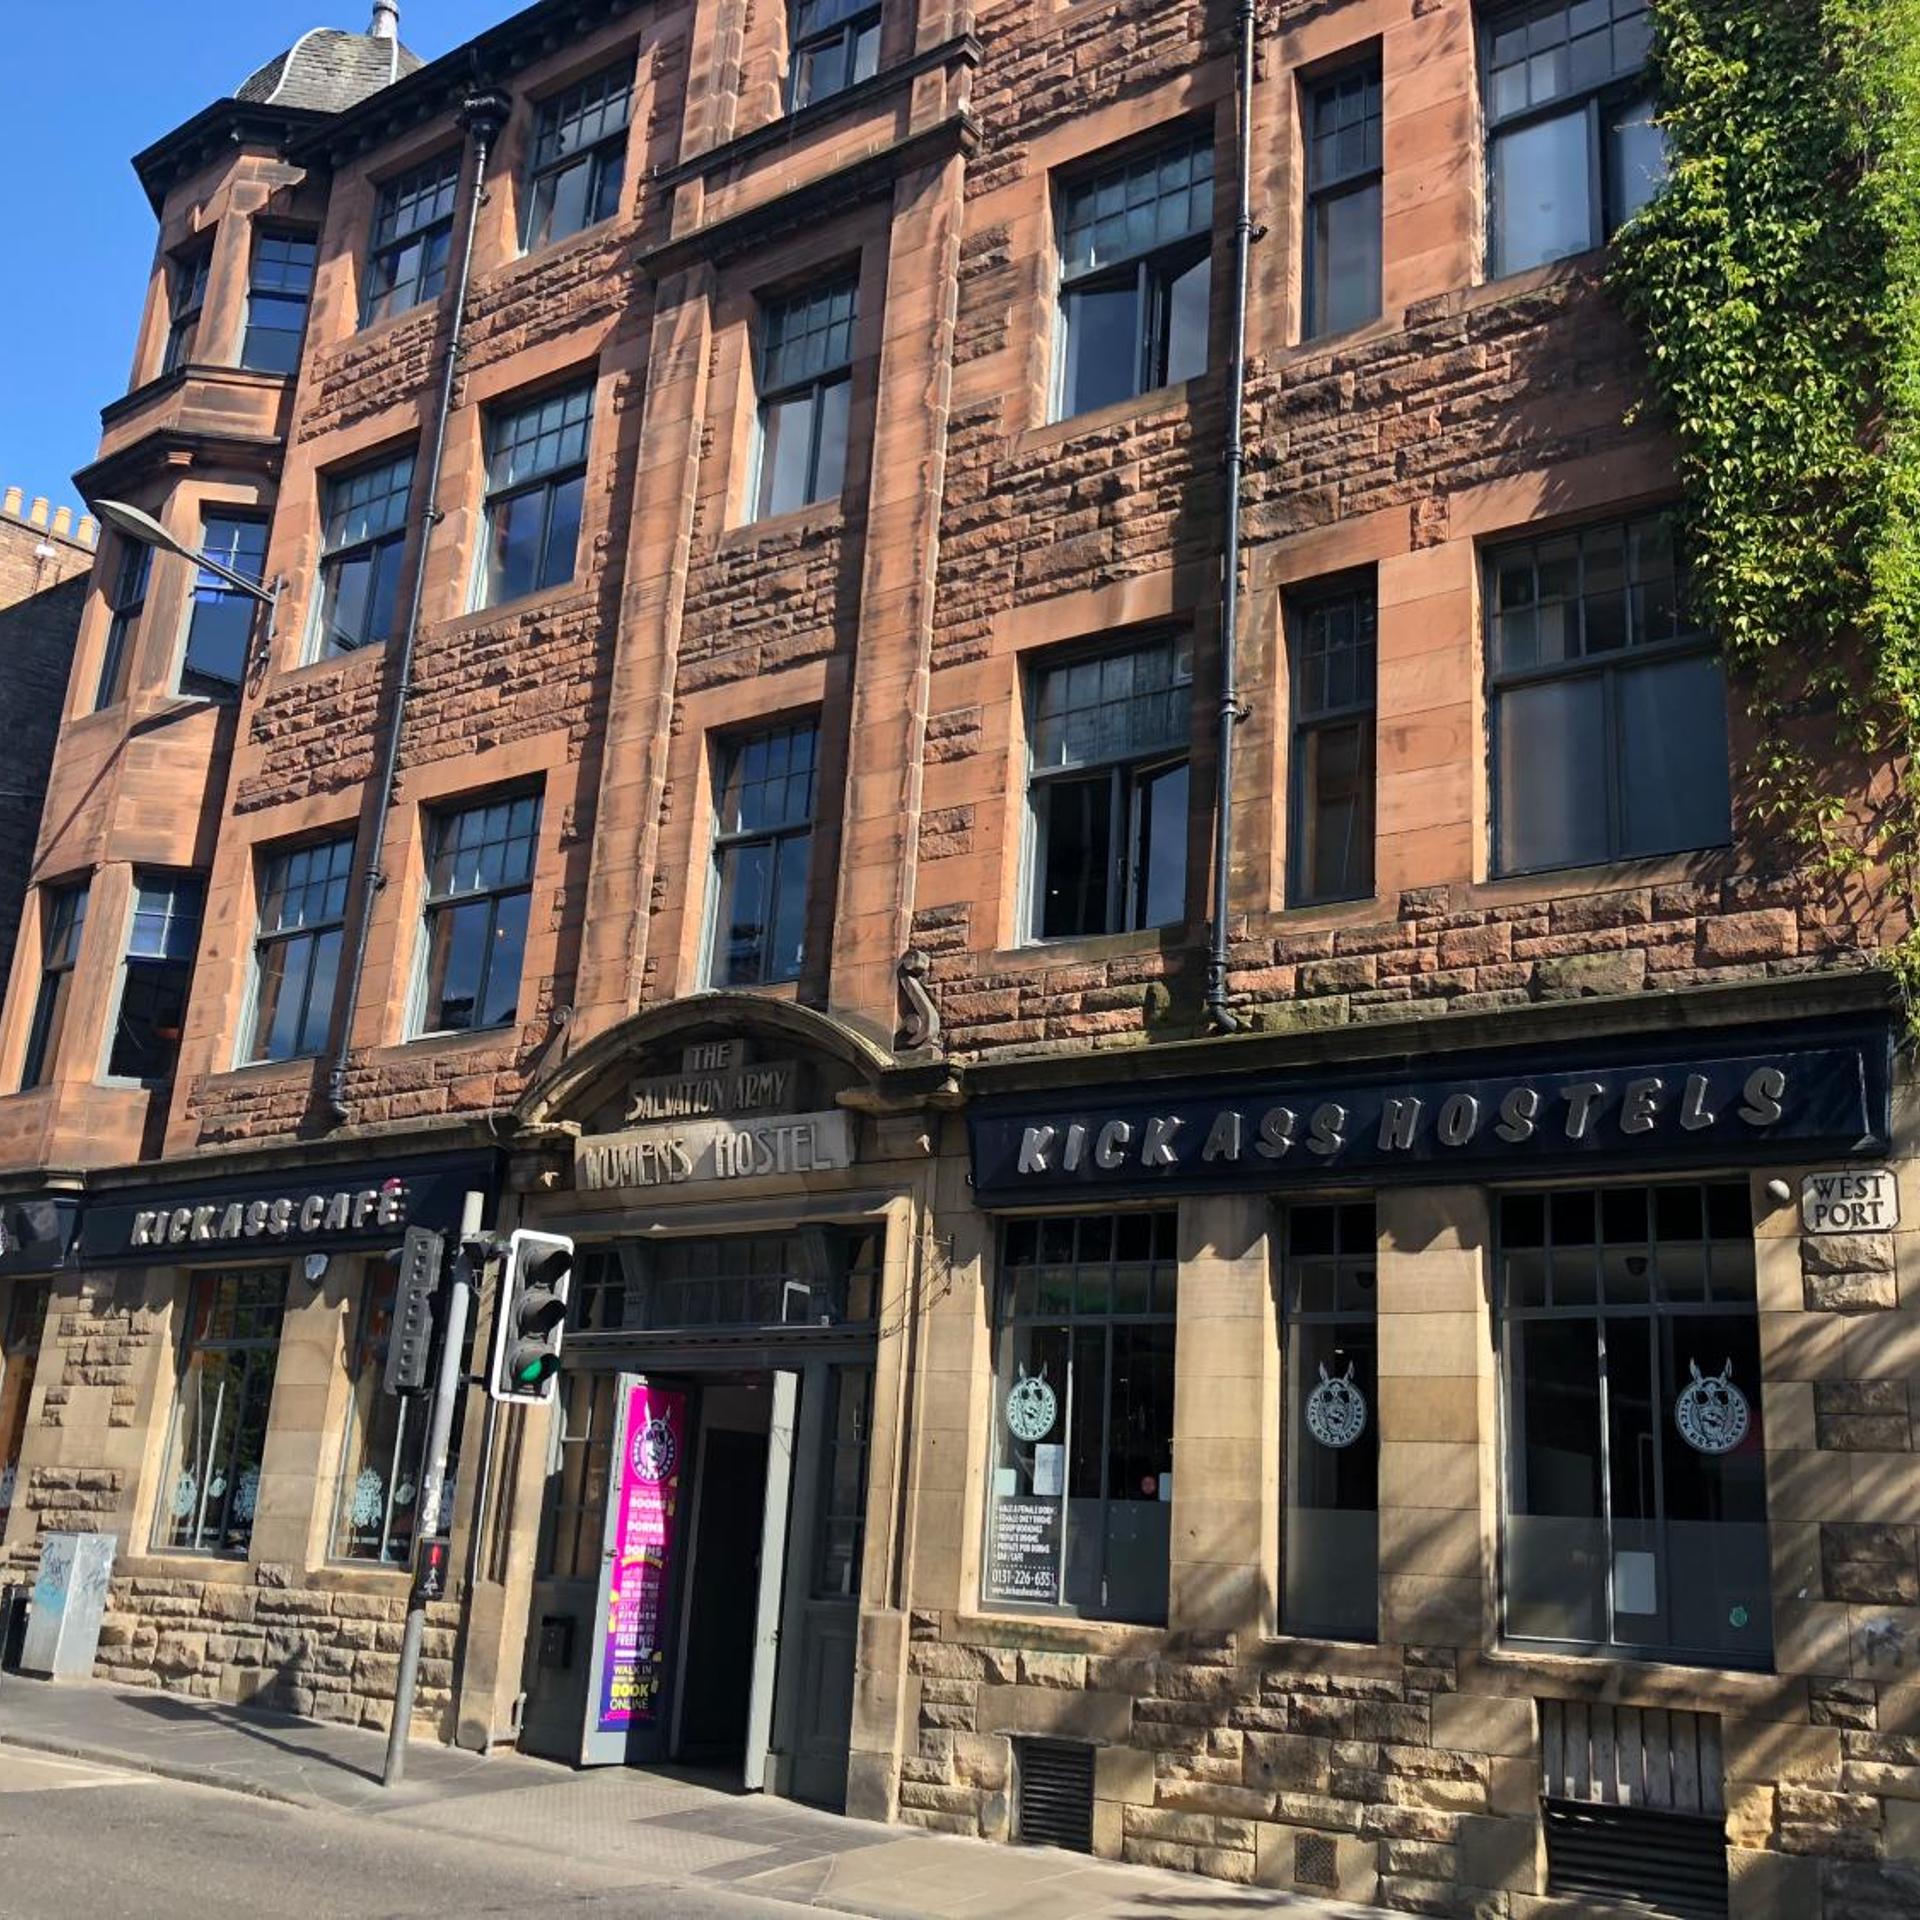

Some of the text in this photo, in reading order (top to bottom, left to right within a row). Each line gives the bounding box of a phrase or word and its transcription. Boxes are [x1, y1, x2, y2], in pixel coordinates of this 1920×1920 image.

[691, 1043, 732, 1070] THE
[625, 1071, 787, 1121] SALVATION ARMY
[1377, 1066, 1787, 1151] HOSTELS
[585, 1124, 831, 1189] WOMENS HOSTEL
[1812, 1174, 1886, 1199] WEST
[1814, 1200, 1884, 1228] PORT
[609, 1697, 649, 1711] ONLINE
[611, 1683, 649, 1698] BOOK
